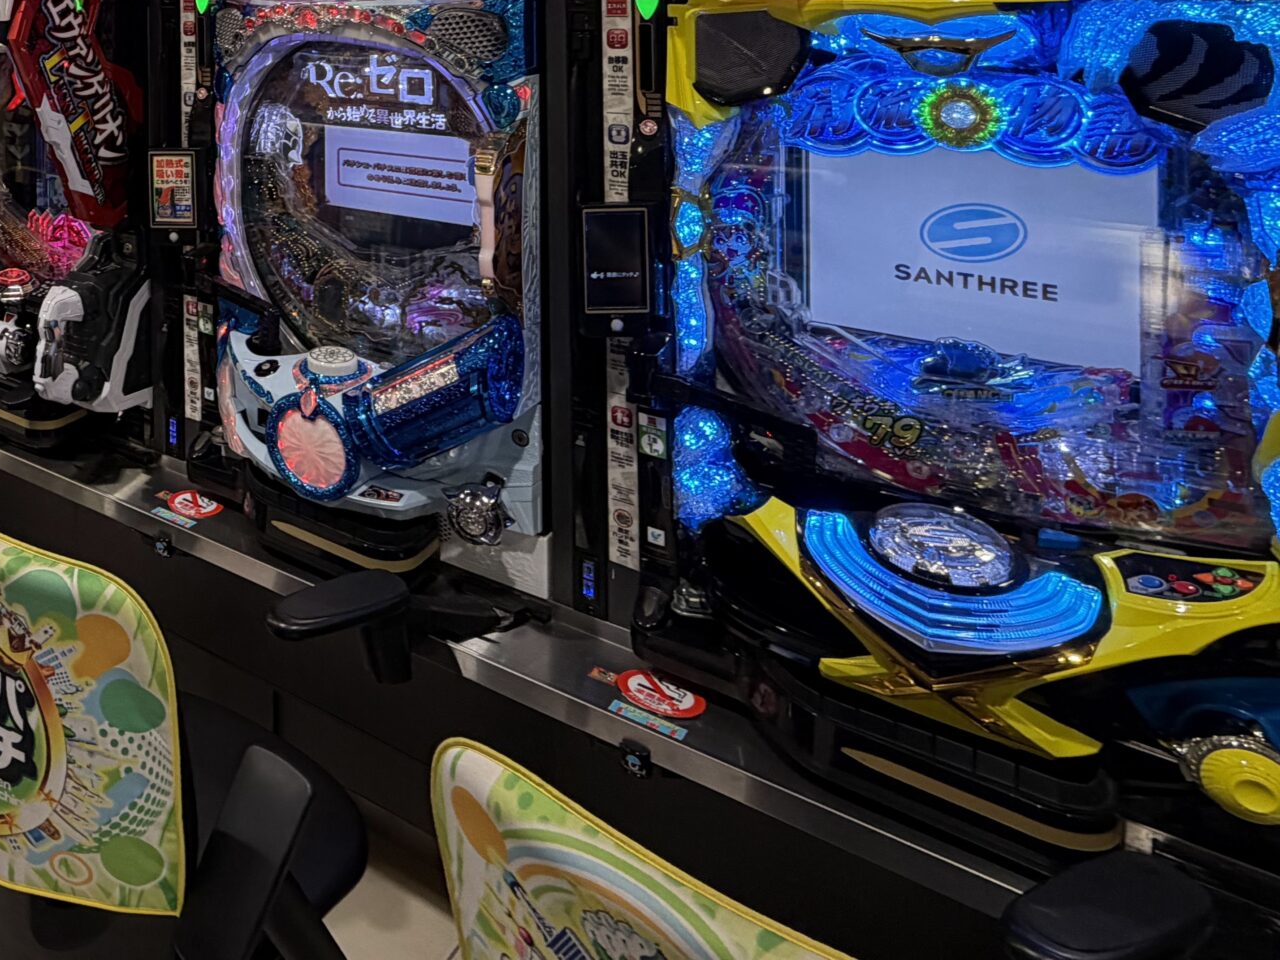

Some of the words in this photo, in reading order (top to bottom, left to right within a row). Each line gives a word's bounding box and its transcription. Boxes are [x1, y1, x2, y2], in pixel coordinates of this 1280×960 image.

[302, 53, 434, 105] Re:ゼロ
[326, 105, 447, 131] から始める異世界生活
[893, 262, 1060, 304] SANTHREE
[864, 415, 922, 447] 79
